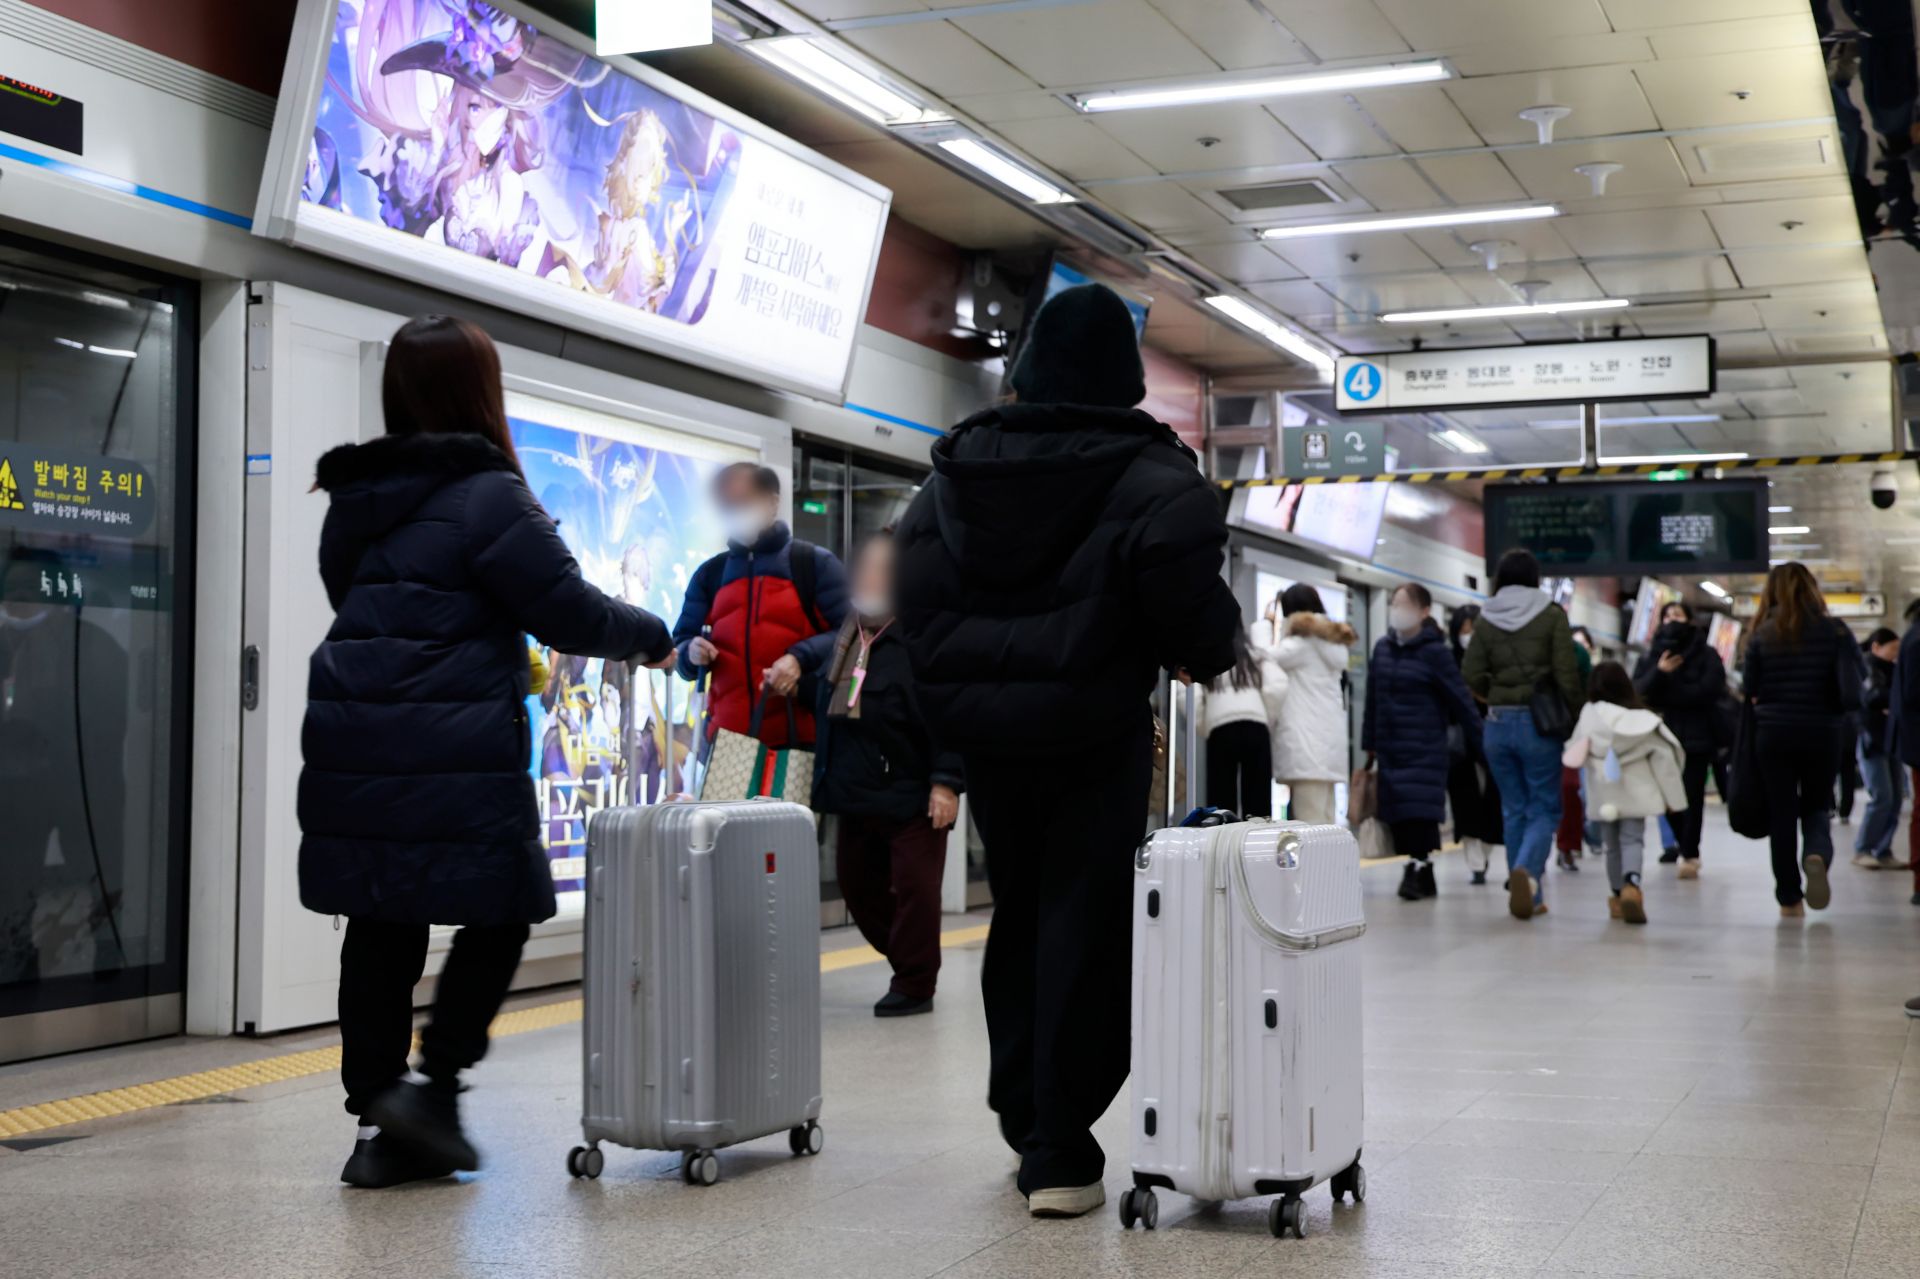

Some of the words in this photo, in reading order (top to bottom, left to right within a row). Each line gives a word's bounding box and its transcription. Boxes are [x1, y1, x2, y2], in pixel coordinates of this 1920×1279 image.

[1349, 364, 1373, 398] 4
[33, 460, 88, 492] 발빠짐
[99, 470, 144, 498] 주의!
[33, 488, 55, 500] Watch
[56, 491, 71, 502] your
[32, 501, 55, 516] 열차와
[57, 504, 79, 520] 승강장
[80, 507, 102, 521] 사이가
